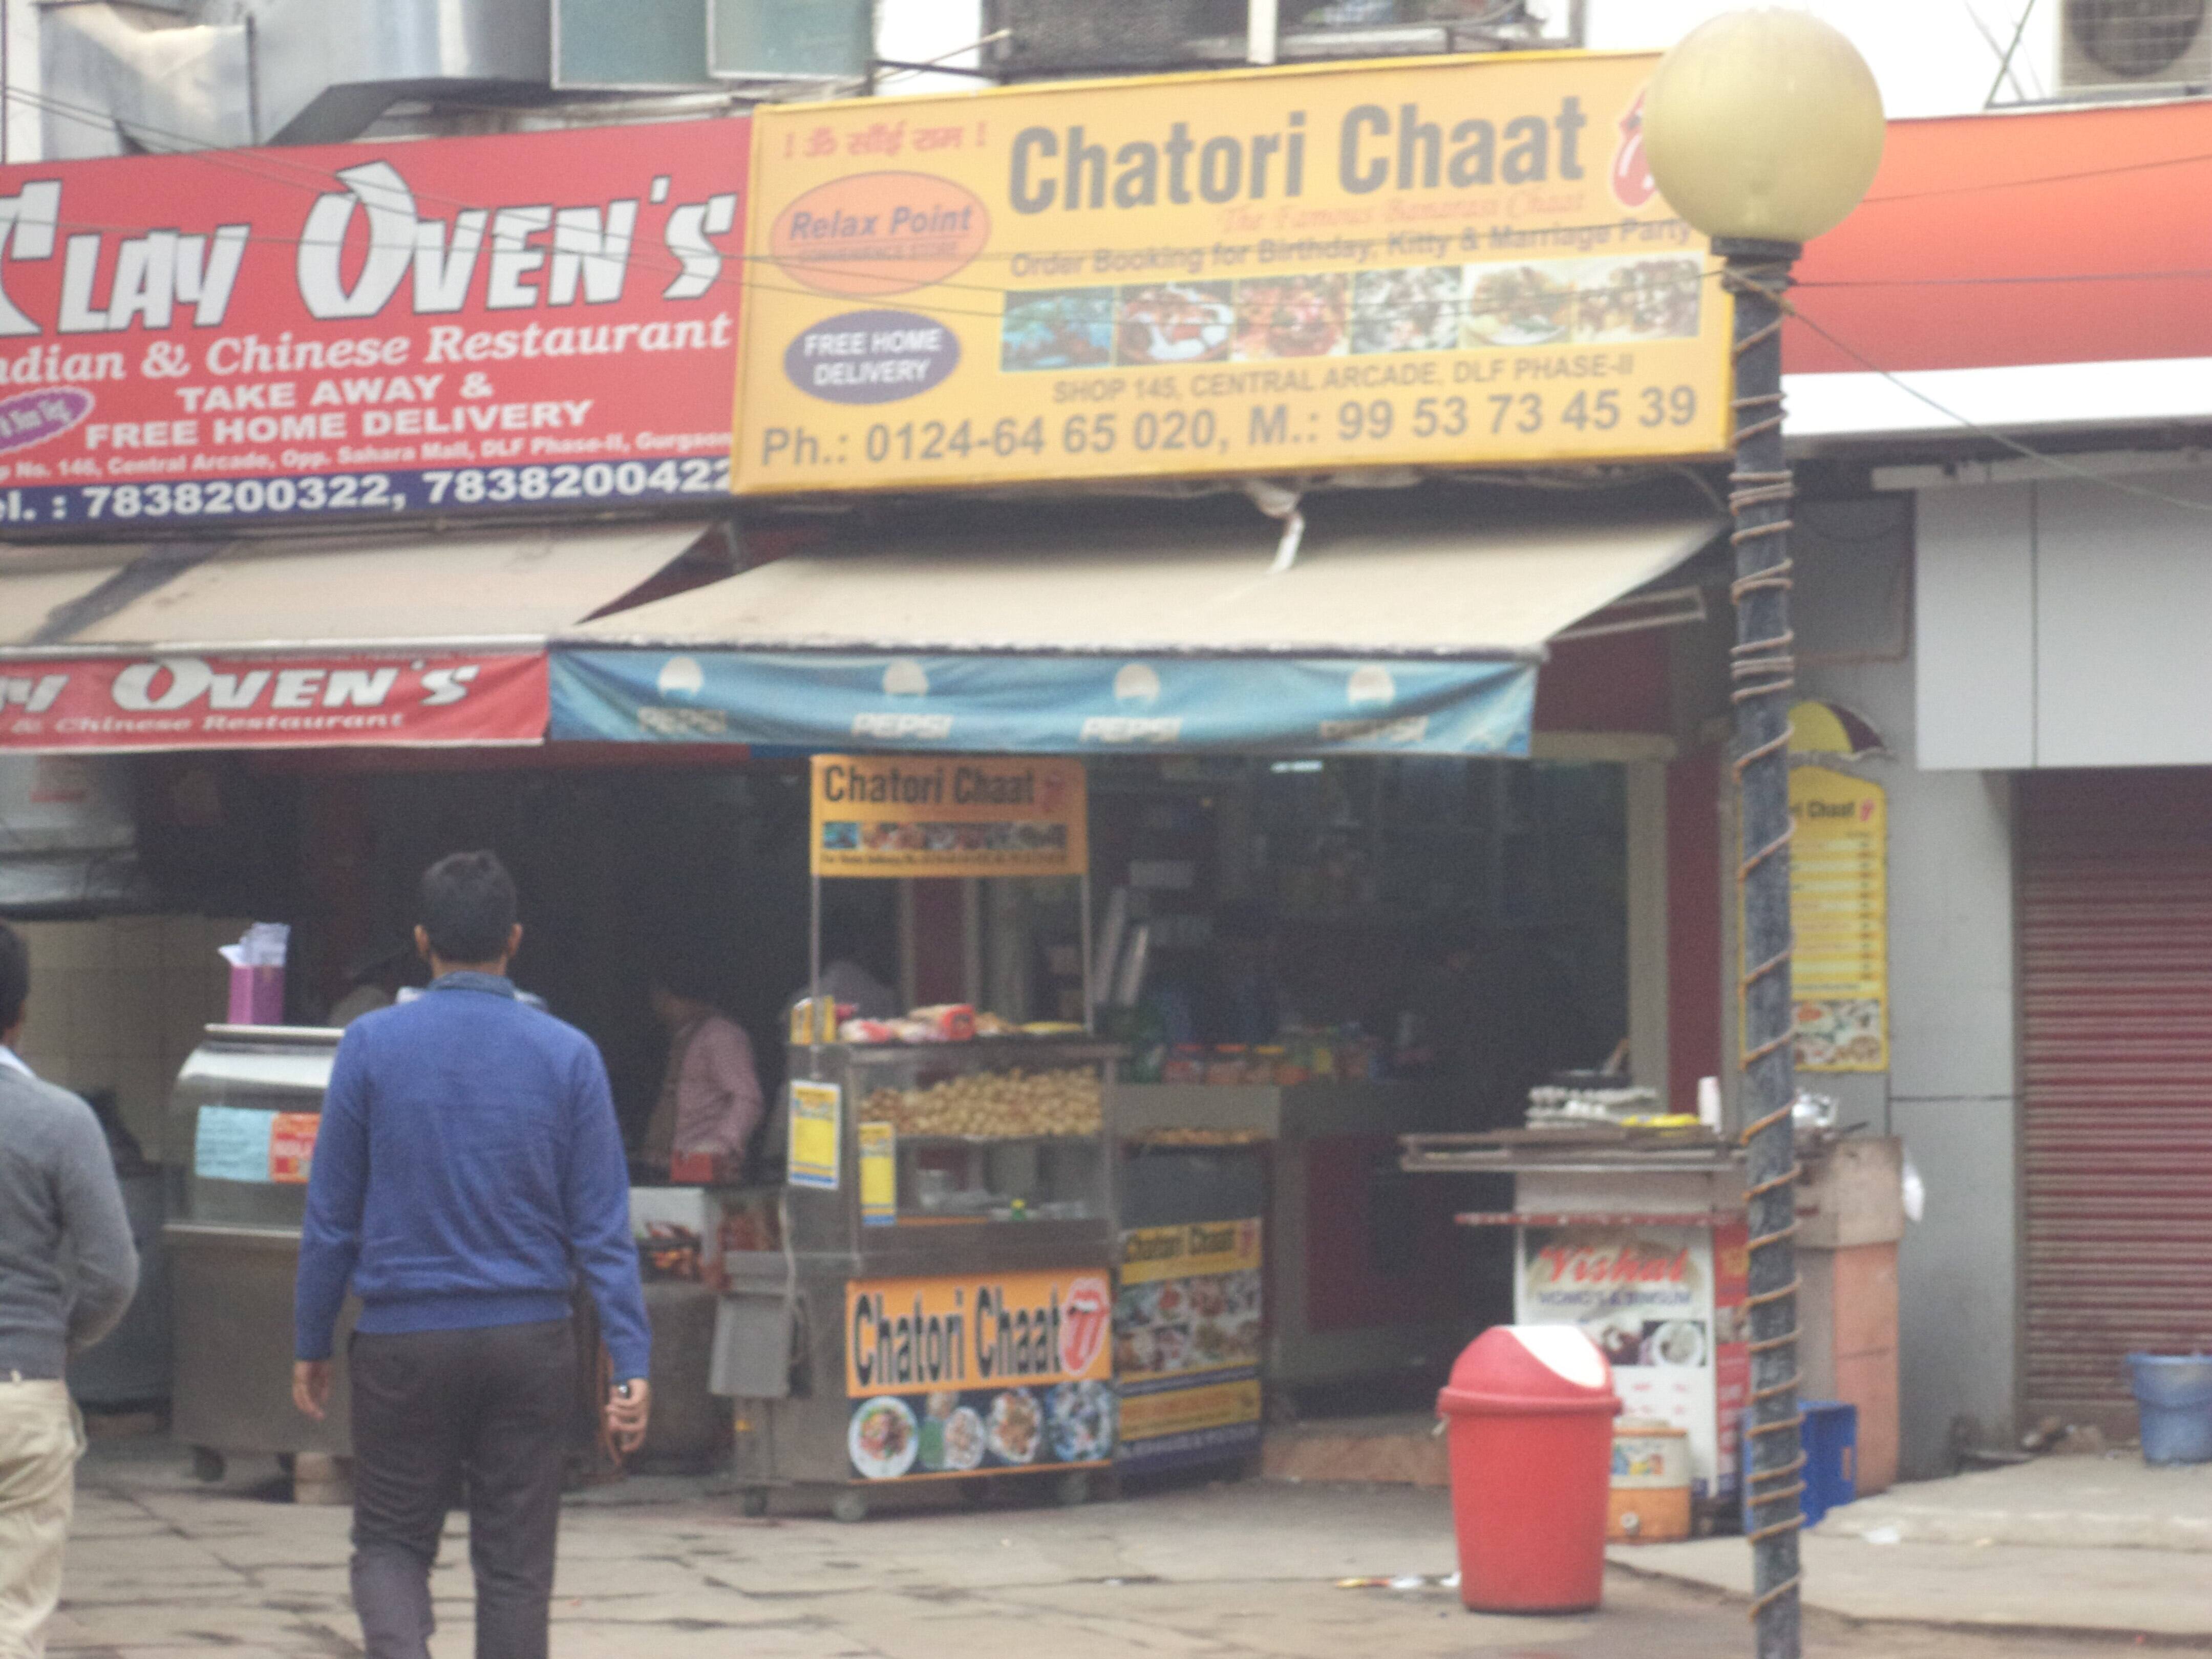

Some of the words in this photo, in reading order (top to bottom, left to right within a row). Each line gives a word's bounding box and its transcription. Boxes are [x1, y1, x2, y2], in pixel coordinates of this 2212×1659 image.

[1009, 110, 1306, 215] Chatori
[1337, 95, 1587, 194] Chaat
[789, 210, 877, 241] Relax
[889, 204, 972, 235] Point
[1011, 251, 1085, 277] Order
[1093, 248, 1204, 274] Booking
[1211, 241, 1251, 266] for
[1388, 229, 1451, 257] Kitty
[1461, 227, 1480, 251] &
[1489, 223, 1612, 252] Marriage
[1619, 218, 1690, 244] Party
[141, 340, 192, 379] &
[207, 331, 410, 377] Chinese
[424, 312, 733, 363] Restaurant
[803, 332, 867, 357] FREE
[871, 328, 943, 353] HOME
[177, 381, 296, 413] TAKE
[311, 374, 444, 408] AWAY
[459, 371, 494, 399] &
[813, 359, 932, 387] DELIVERY
[1052, 377, 1126, 403] SHOP
[1190, 369, 1311, 398] CENTRAL
[1321, 361, 1444, 390] ARCADE,
[1453, 358, 1505, 385] DLF
[86, 420, 199, 450] FREE
[213, 413, 347, 444] HOME
[363, 398, 594, 436] DELIVERY
[866, 416, 1045, 462] 0124-64
[1063, 412, 1118, 455] 65
[1133, 408, 1229, 455] 020,
[1337, 399, 1394, 442] 99
[1412, 395, 1470, 438] 53
[1486, 391, 1544, 435] 73
[1560, 388, 1622, 431] 45
[1637, 384, 1698, 428] 39
[108, 453, 186, 476] Central
[480, 437, 524, 459] DLF
[82, 472, 407, 519] 7838200322,
[54, 716, 193, 734] Chinese
[202, 712, 403, 732] Restaurant
[824, 764, 943, 803] Chatori
[954, 767, 1034, 804] Chaat
[854, 1286, 964, 1388] Chatori
[975, 1283, 1061, 1379] Chaat
